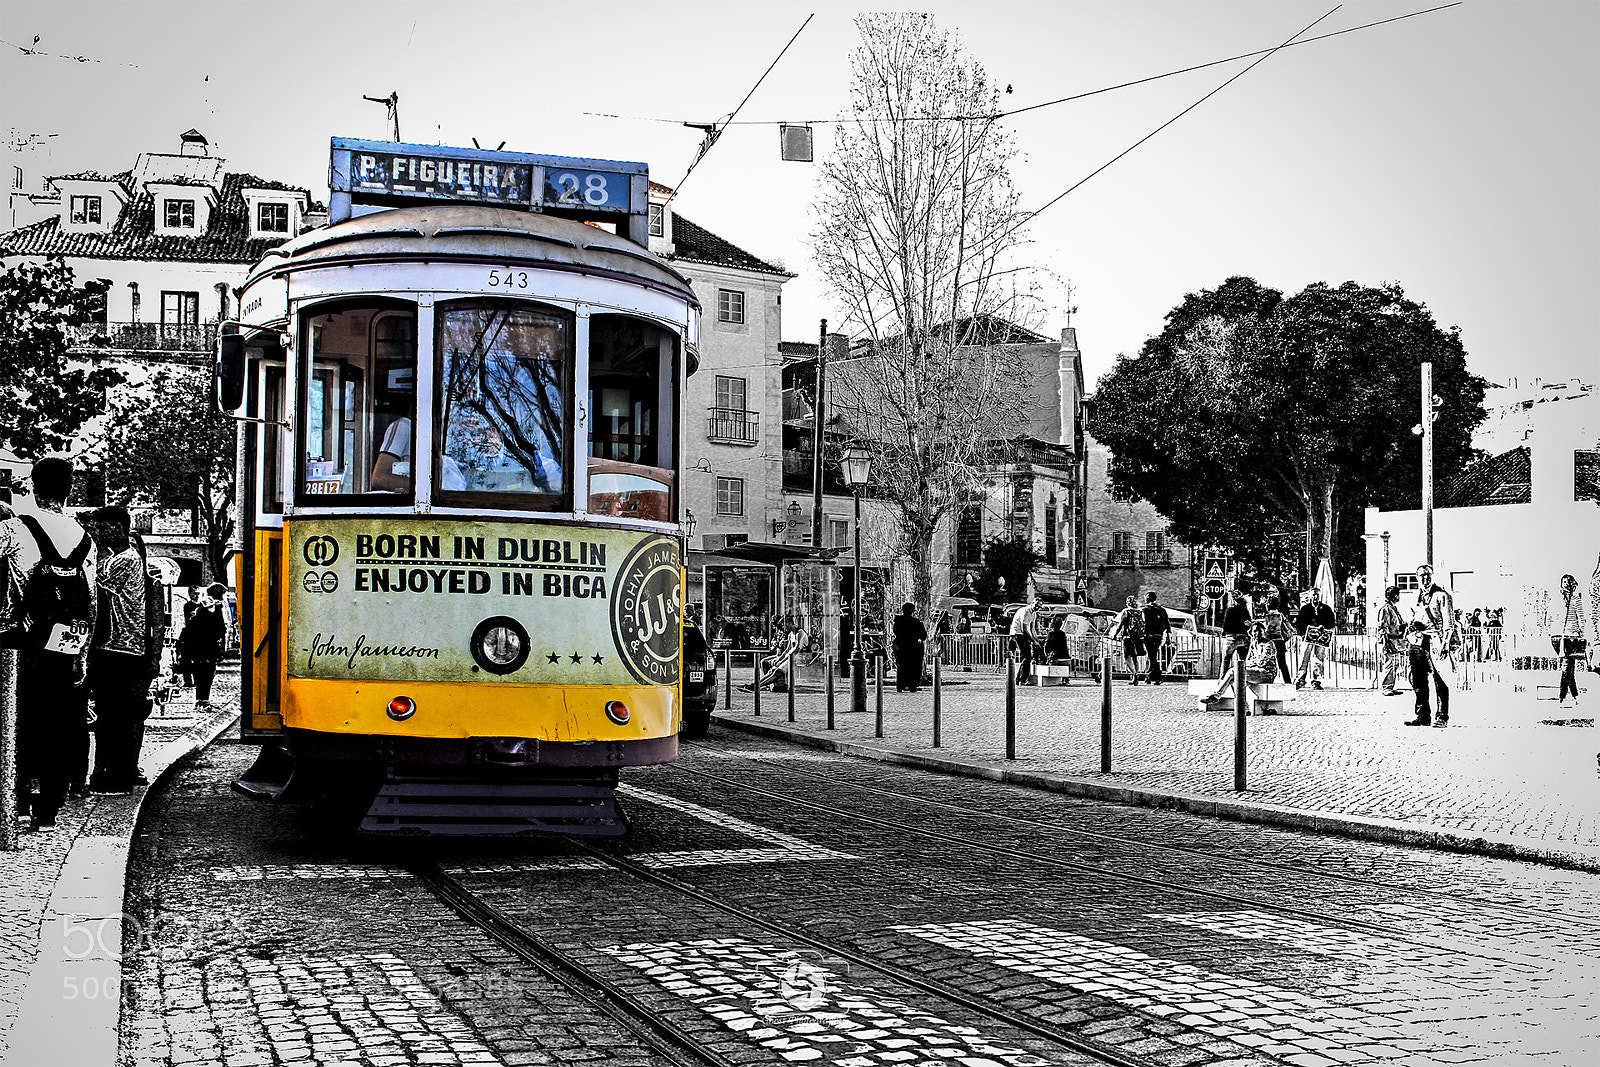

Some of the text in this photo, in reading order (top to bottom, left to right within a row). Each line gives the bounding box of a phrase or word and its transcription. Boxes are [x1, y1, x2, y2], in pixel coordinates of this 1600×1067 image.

[392, 157, 517, 189] FIGUEIRA
[558, 172, 609, 206] 28
[488, 270, 528, 288] 543
[356, 534, 607, 566] BORN IN DUBLIN
[354, 568, 607, 599] ENJOYED IN BICA
[624, 568, 644, 623] JOHN
[1205, 585, 1224, 593] STOP
[750, 636, 767, 646] Syfy
[641, 654, 667, 678] SON
